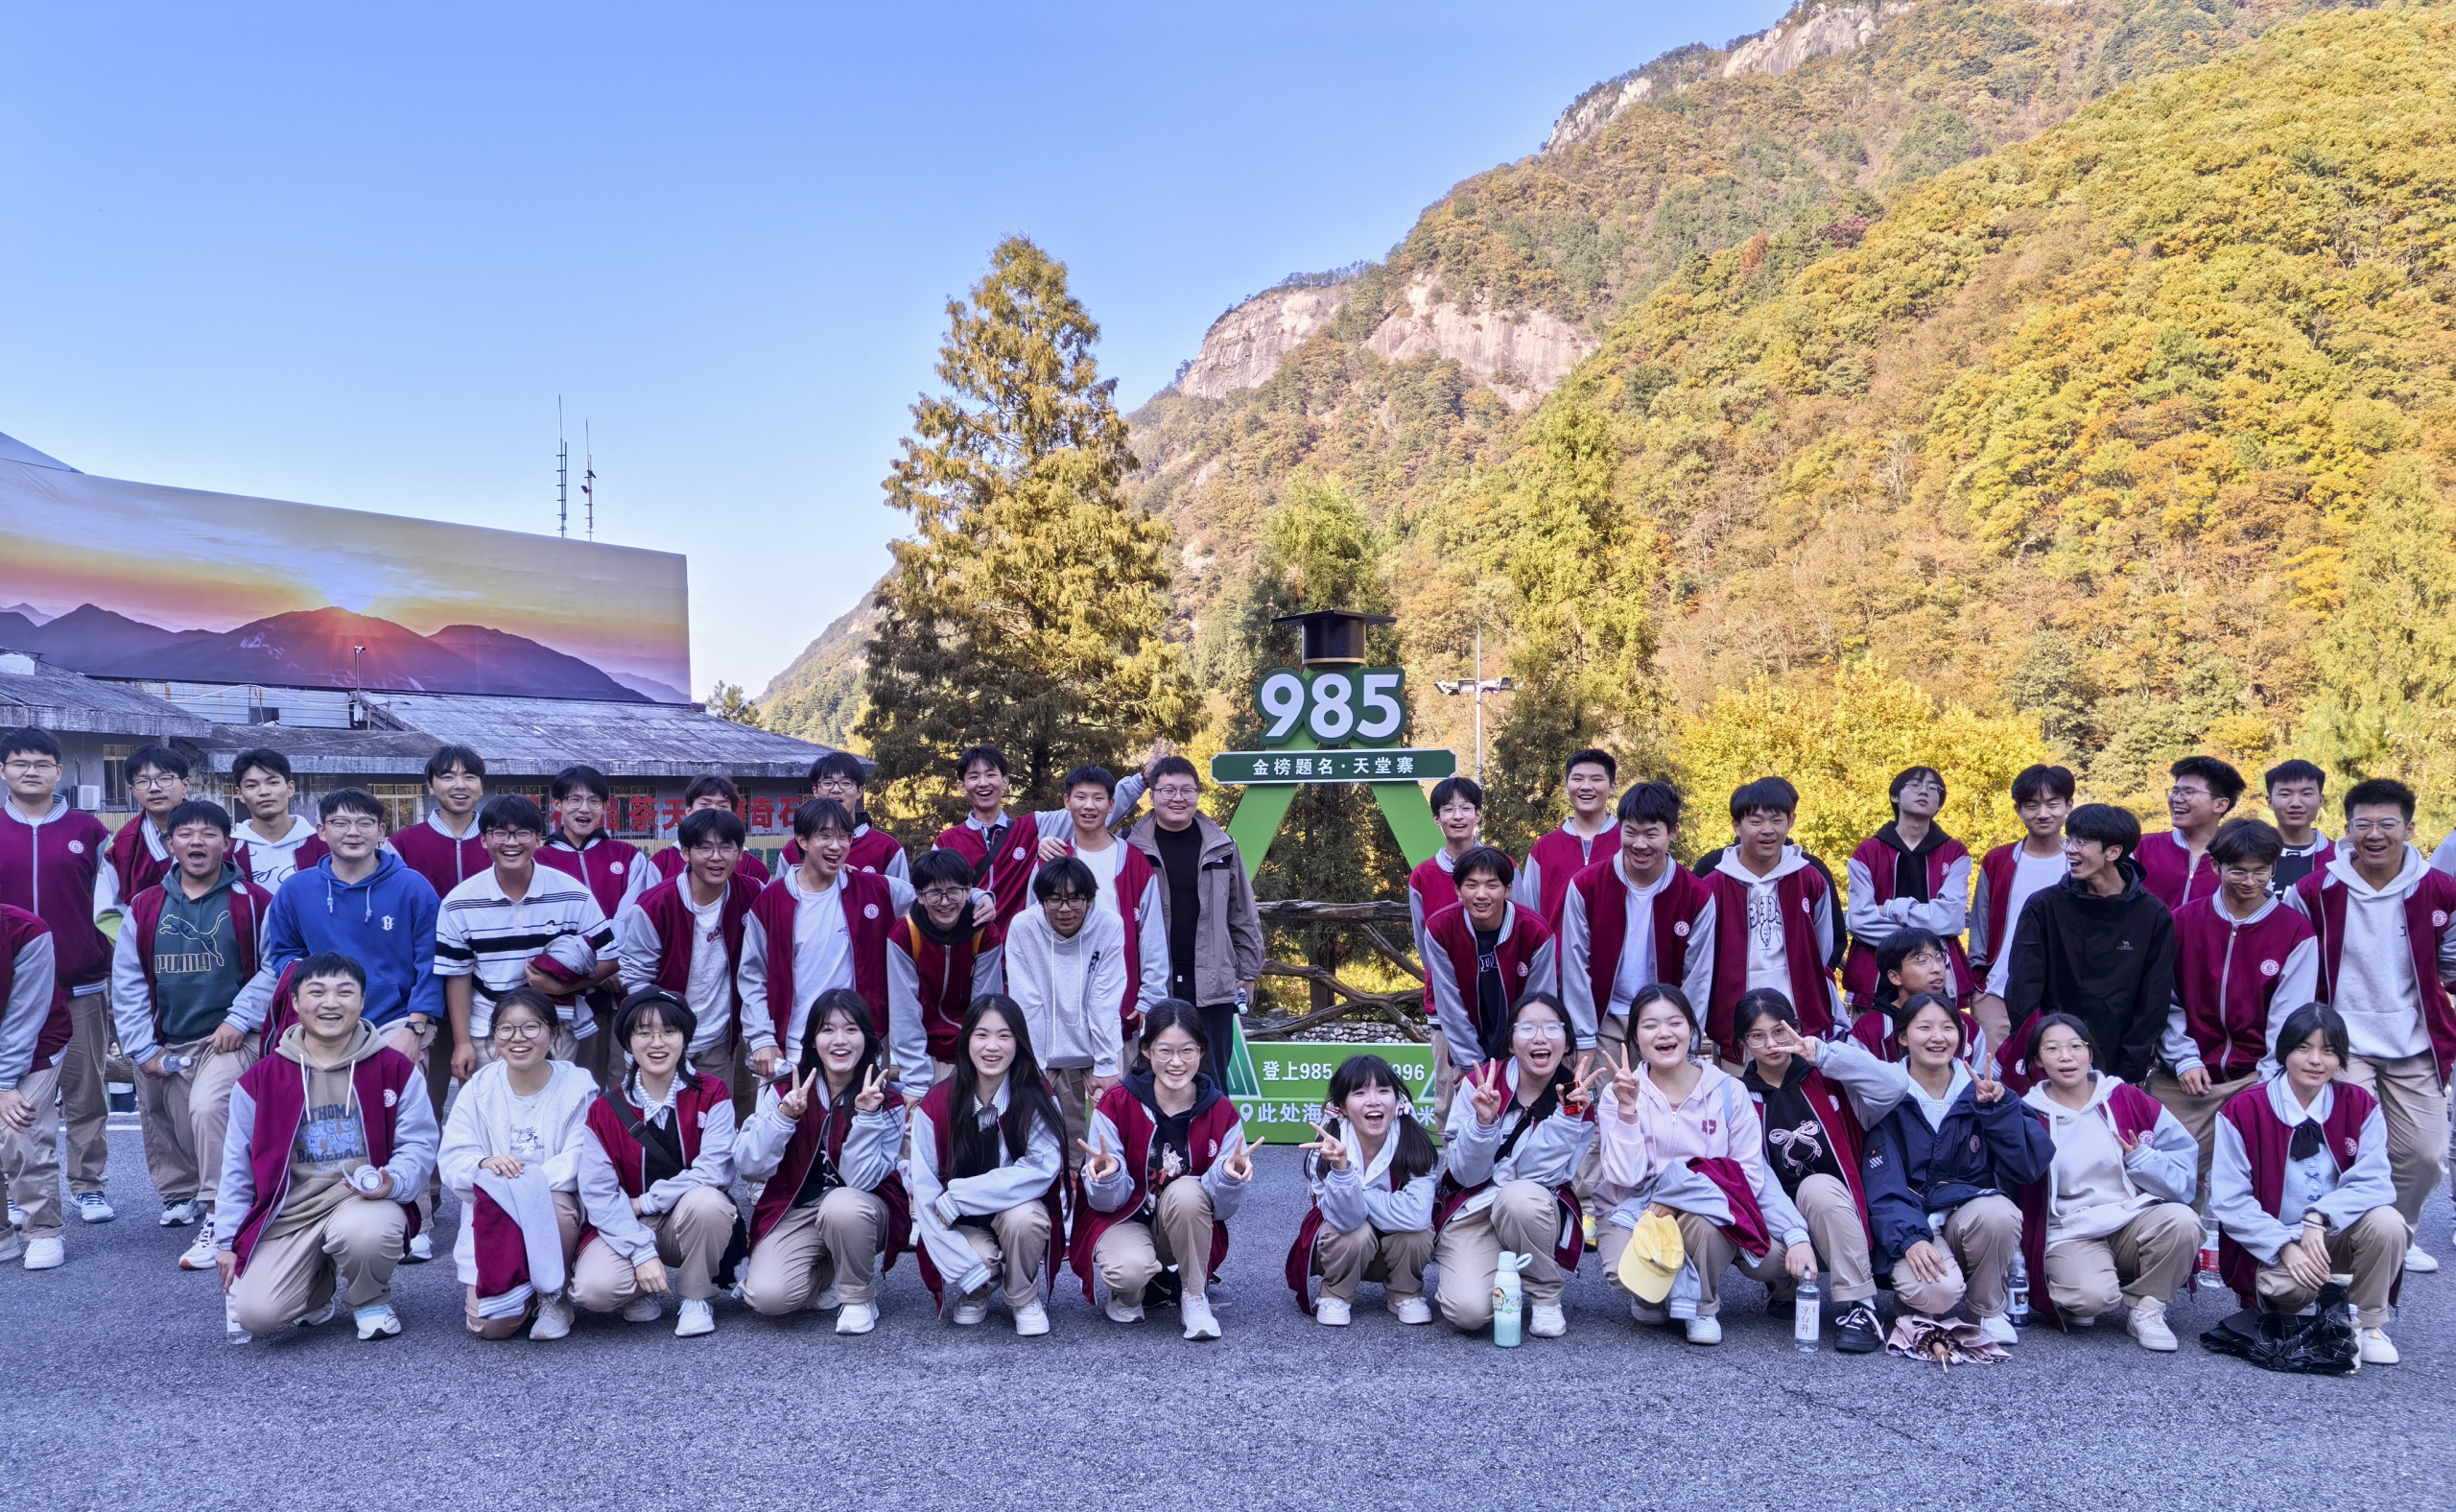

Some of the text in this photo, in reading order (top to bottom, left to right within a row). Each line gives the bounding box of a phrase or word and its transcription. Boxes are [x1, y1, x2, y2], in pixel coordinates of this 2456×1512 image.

[1261, 673, 1401, 739] 985
[1252, 756, 1414, 776] 金榜题名·天堂寨
[154, 953, 211, 973] PUMA
[1263, 1061, 1333, 1081] 登上985
